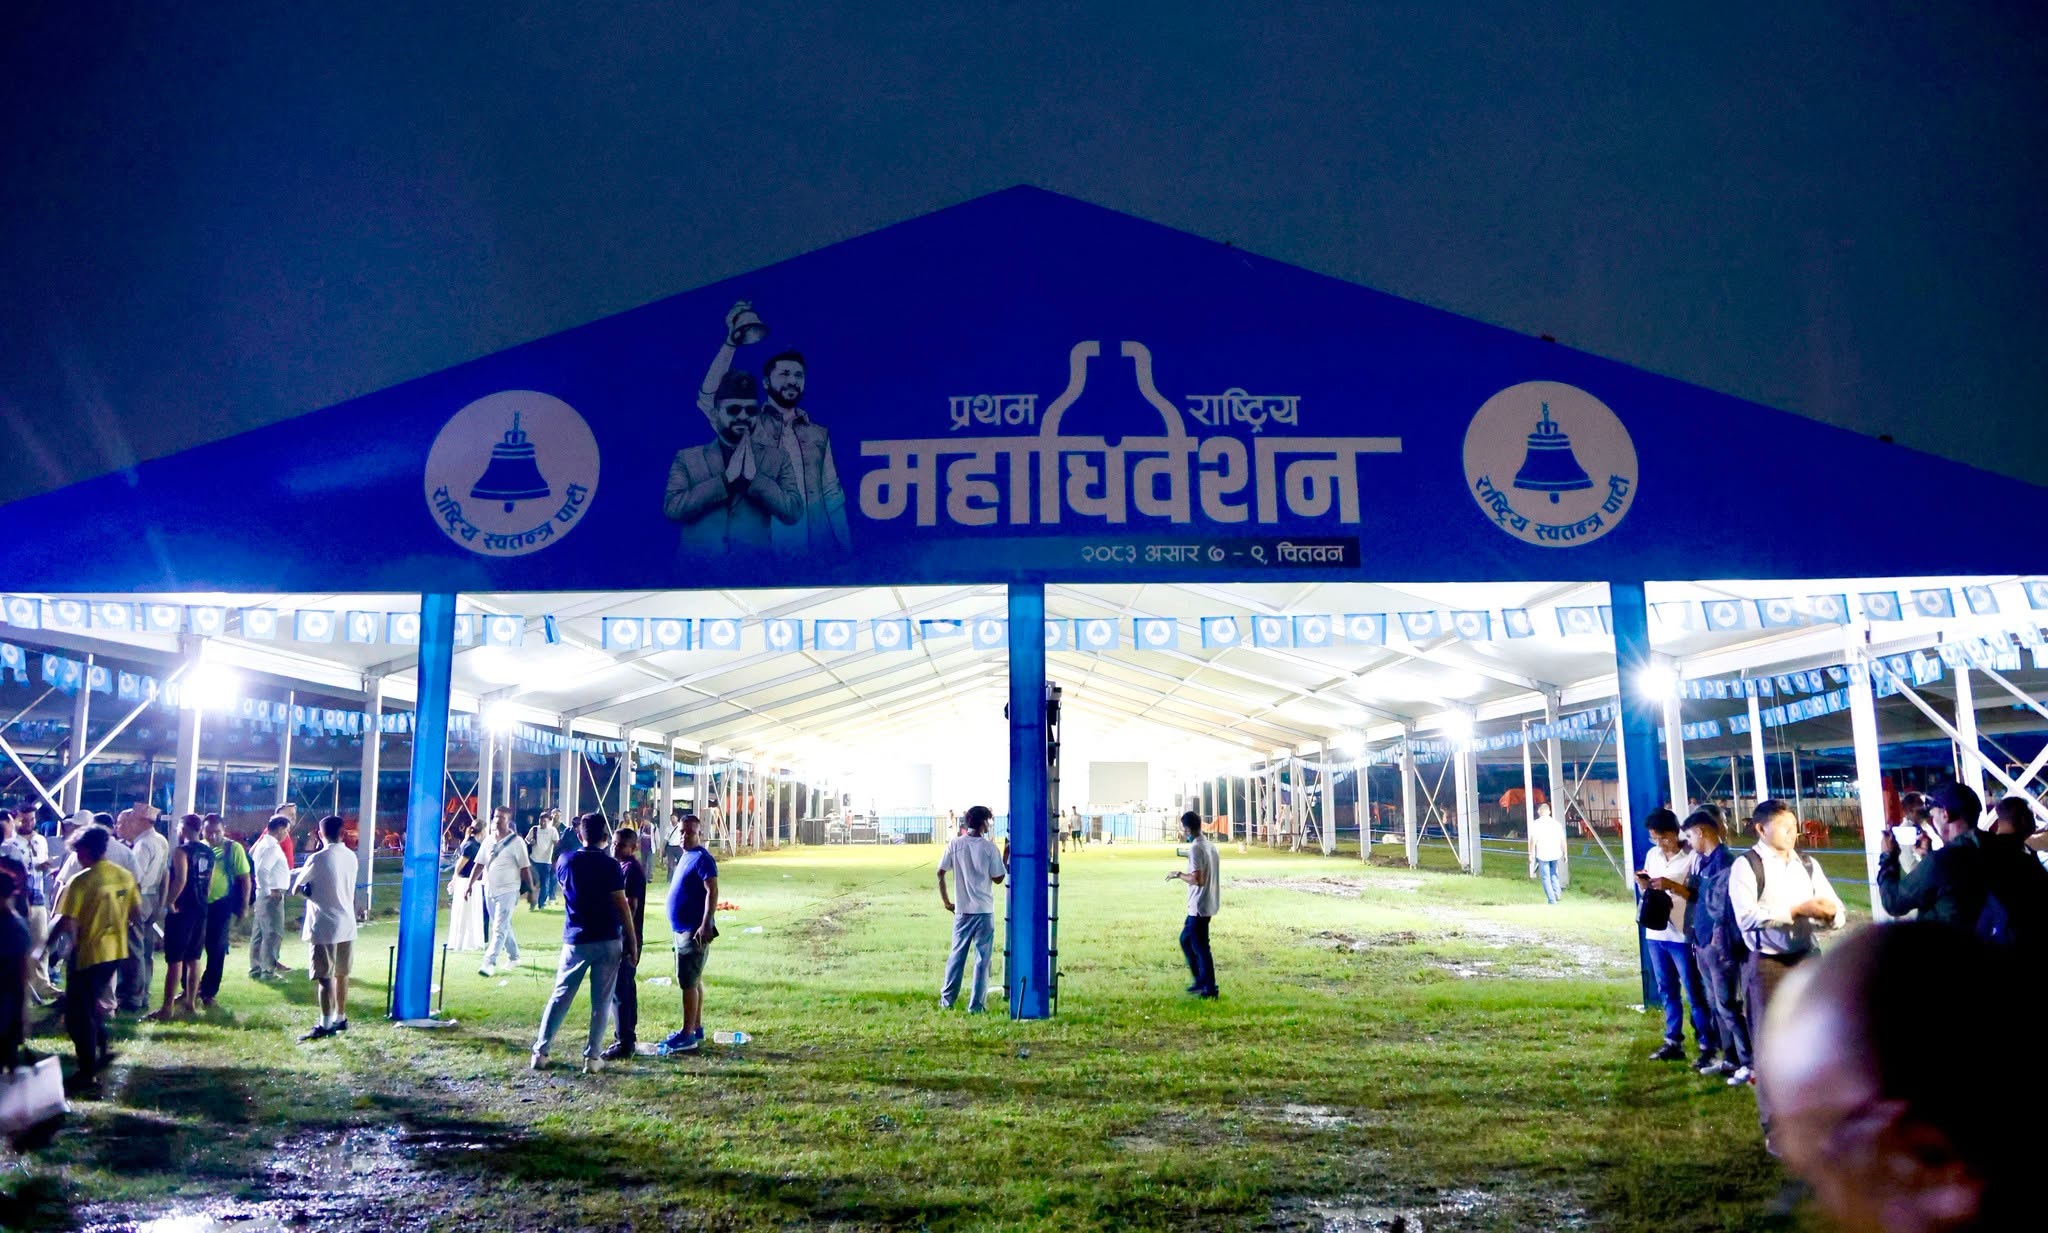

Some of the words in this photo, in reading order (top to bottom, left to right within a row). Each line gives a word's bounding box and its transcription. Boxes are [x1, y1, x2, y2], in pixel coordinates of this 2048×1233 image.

[948, 393, 1039, 431] प्रथम
[1185, 387, 1301, 433] राष्ट्रिय
[1081, 545, 1137, 564] २०८३
[1144, 545, 1200, 562] असार
[1207, 545, 1225, 562] ७
[1277, 541, 1344, 562] चितवन
